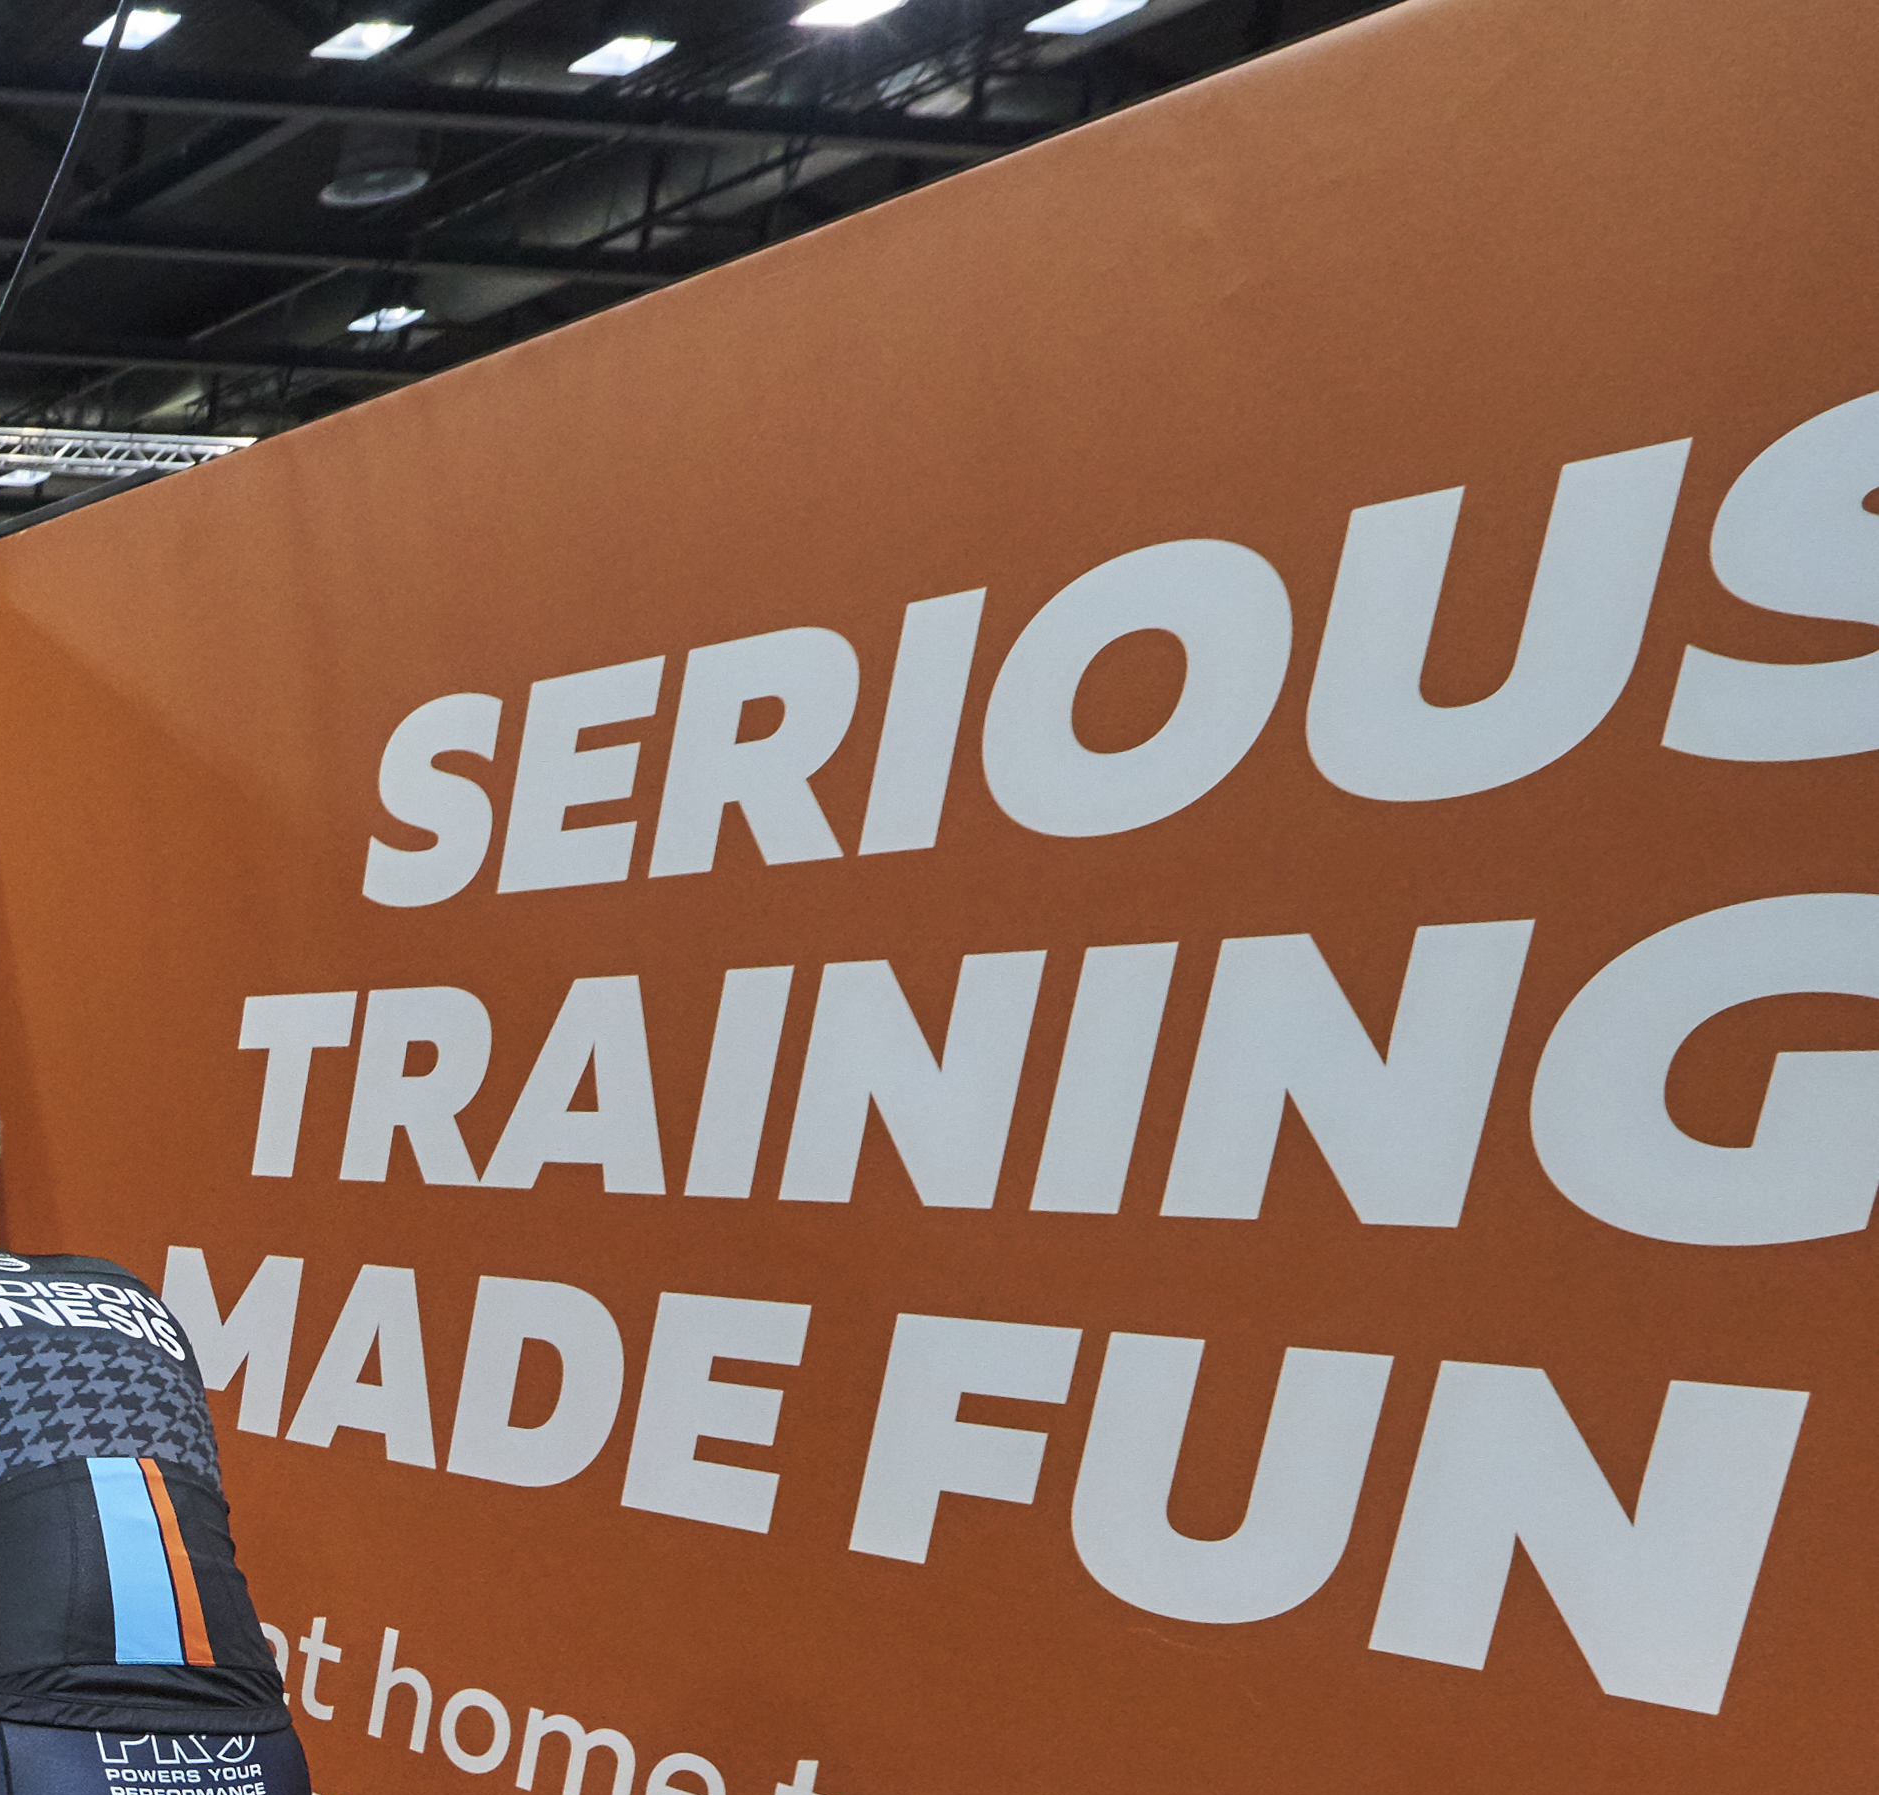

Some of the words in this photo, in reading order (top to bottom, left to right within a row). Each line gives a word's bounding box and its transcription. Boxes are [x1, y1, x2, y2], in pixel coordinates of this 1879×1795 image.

[362, 388, 1879, 908] SERIOUS
[238, 892, 1879, 1247] TRAINING
[162, 1246, 811, 1535] MADE
[848, 1313, 1811, 1716] FUN
[105, 1768, 201, 1783] POWERS
[208, 1763, 262, 1779] YOUR
